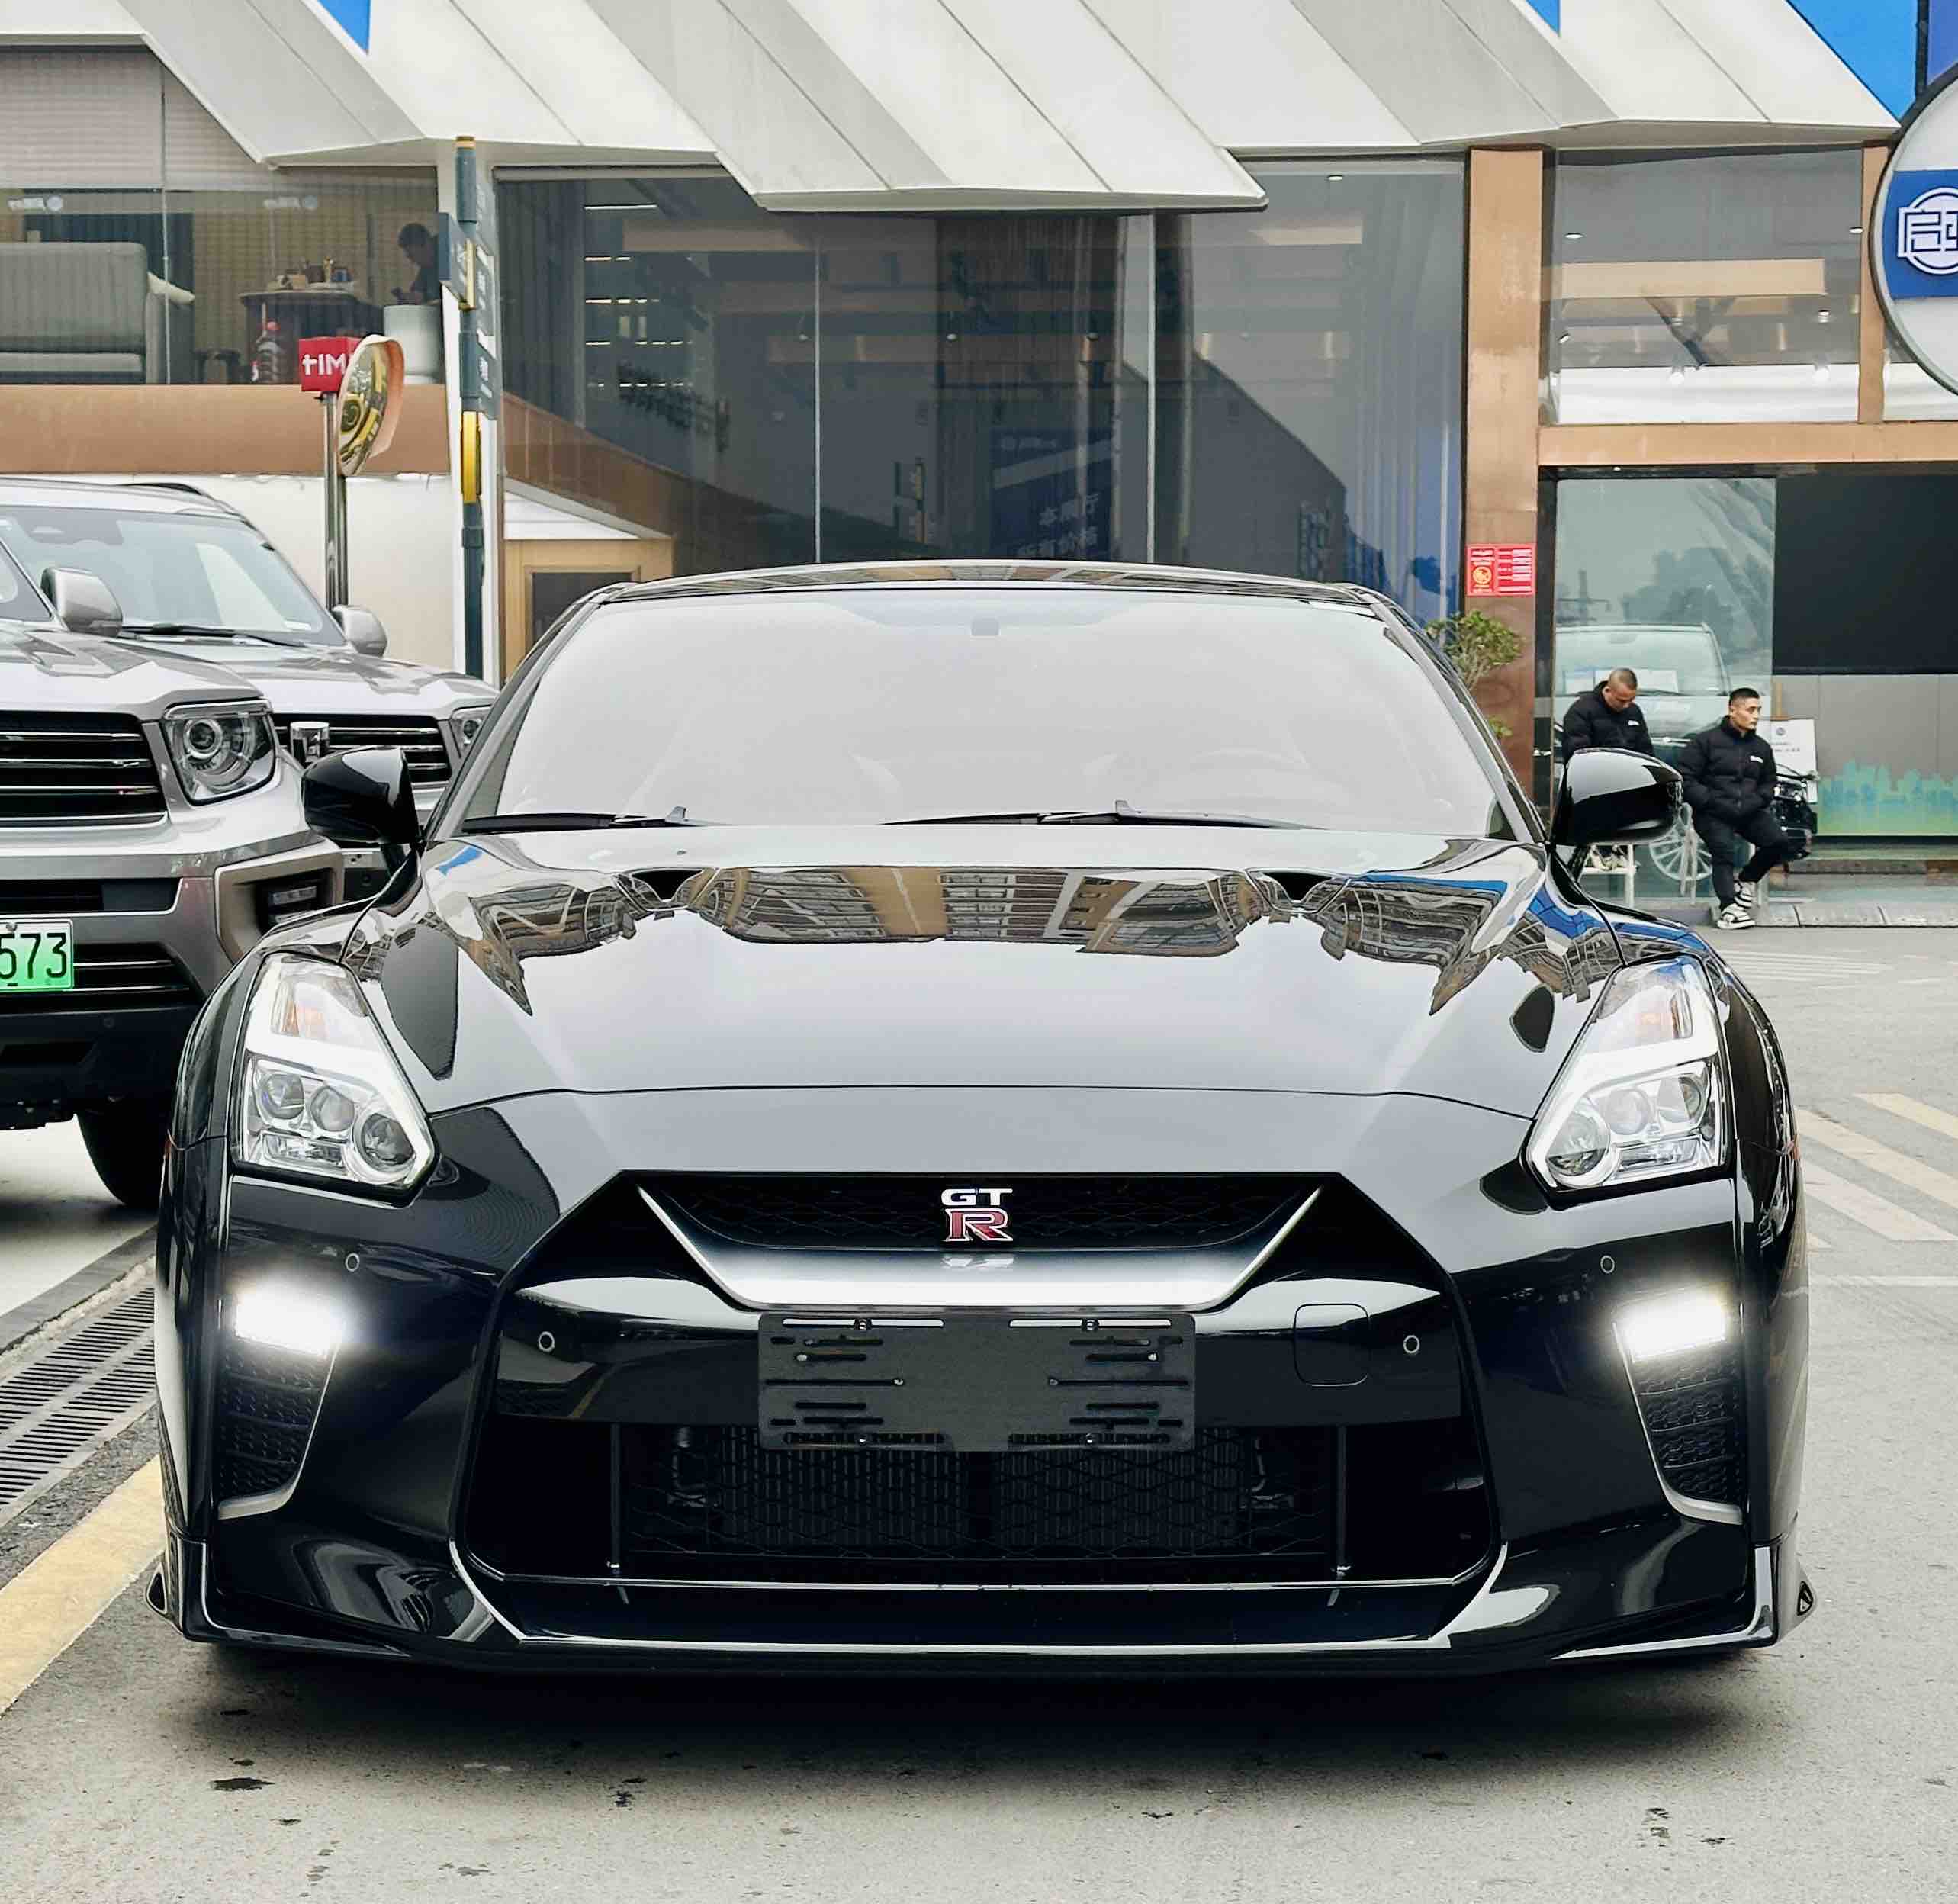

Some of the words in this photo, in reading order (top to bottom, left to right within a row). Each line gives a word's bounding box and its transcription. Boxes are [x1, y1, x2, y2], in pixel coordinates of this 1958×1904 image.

[0, 933, 66, 979] 573
[941, 1188, 1013, 1206] GT
[944, 1208, 1013, 1242] R
